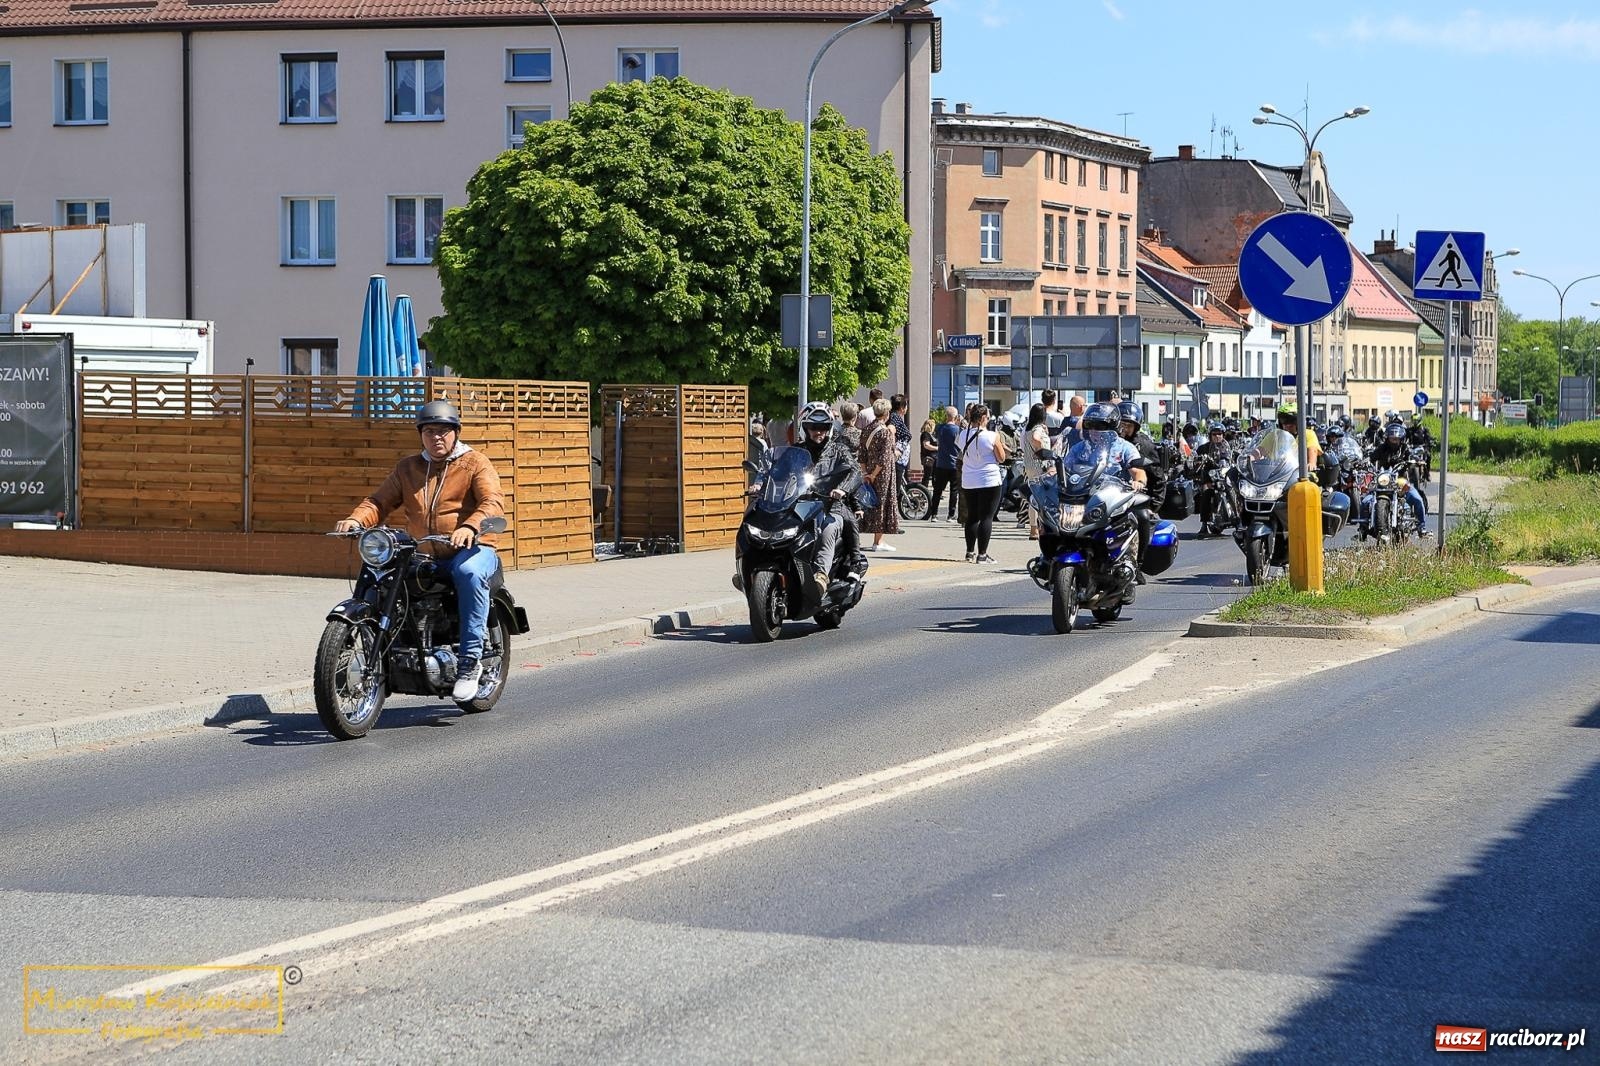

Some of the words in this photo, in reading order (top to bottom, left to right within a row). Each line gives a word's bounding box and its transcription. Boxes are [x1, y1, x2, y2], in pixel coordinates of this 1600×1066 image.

[16, 400, 46, 410] sobota
[0, 481, 16, 494] 91
[20, 481, 45, 494] 962
